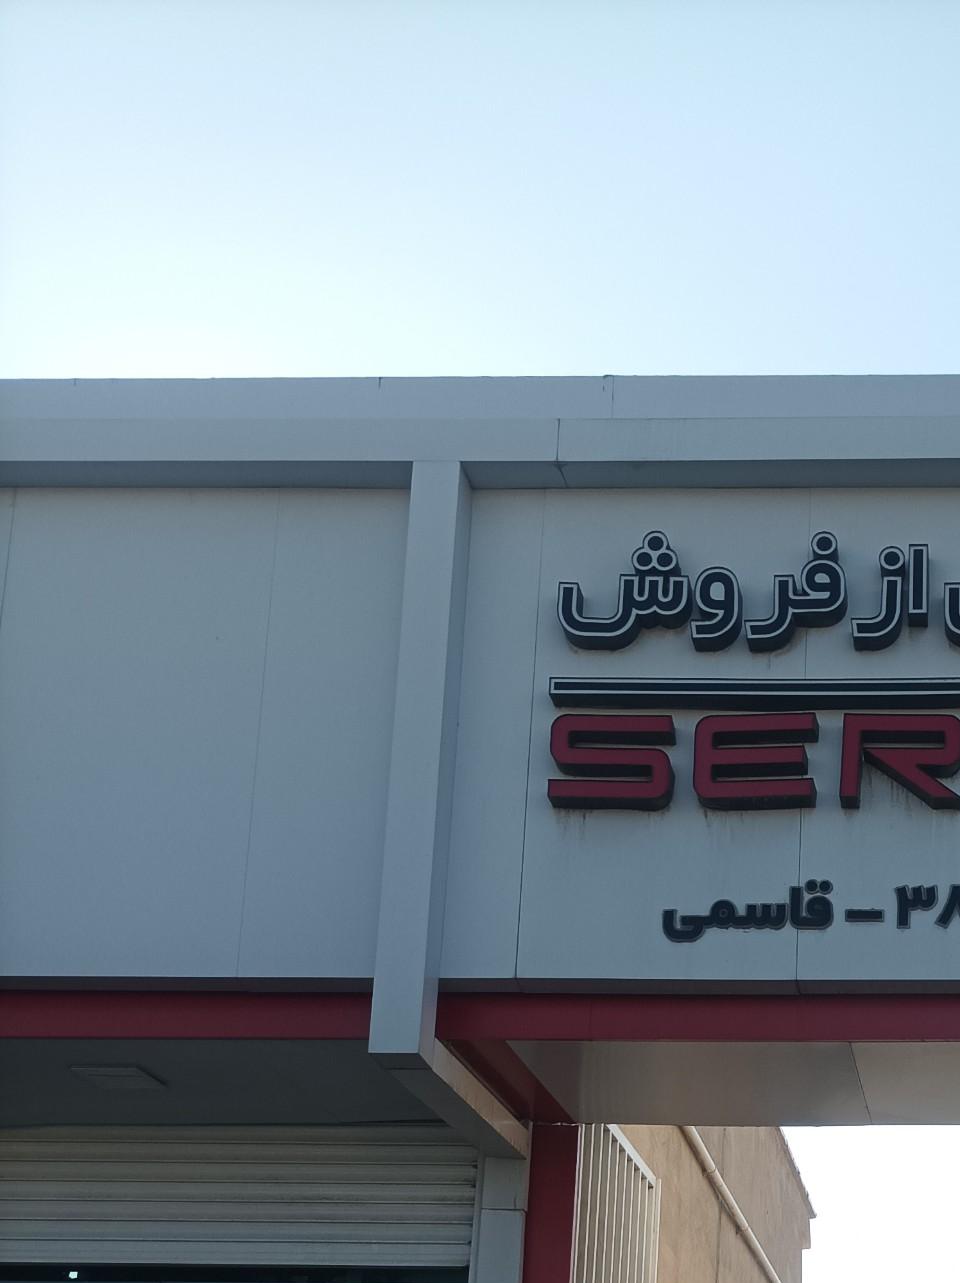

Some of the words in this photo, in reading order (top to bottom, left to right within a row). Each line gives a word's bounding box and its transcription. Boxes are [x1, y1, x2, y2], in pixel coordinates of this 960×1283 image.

[557, 529, 848, 652] فروش
[850, 543, 929, 652] از
[661, 879, 835, 943] قاسمی
